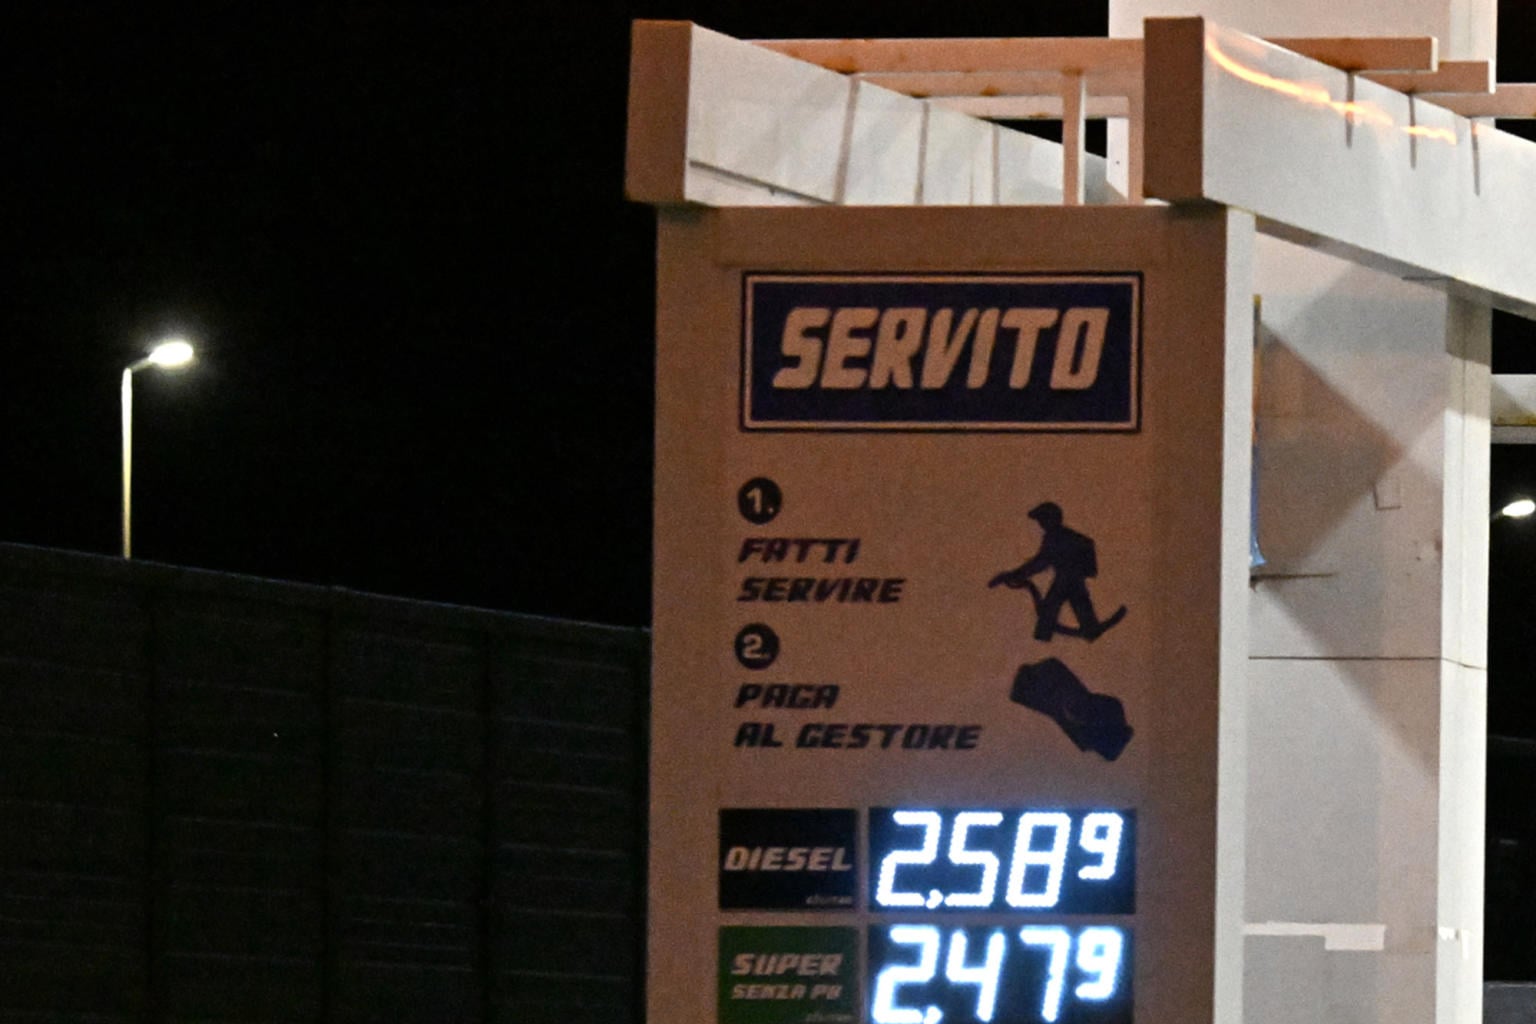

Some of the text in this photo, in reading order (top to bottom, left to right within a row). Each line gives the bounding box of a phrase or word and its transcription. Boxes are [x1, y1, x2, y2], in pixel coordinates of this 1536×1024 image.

[772, 307, 1110, 390] SERVITO
[737, 537, 861, 564] FATTI
[736, 577, 906, 603] SERVIRE
[734, 682, 841, 709] PAGA
[734, 723, 982, 749] AL GESTORE
[724, 846, 852, 872] DIESEL
[731, 953, 843, 977] SUPER
